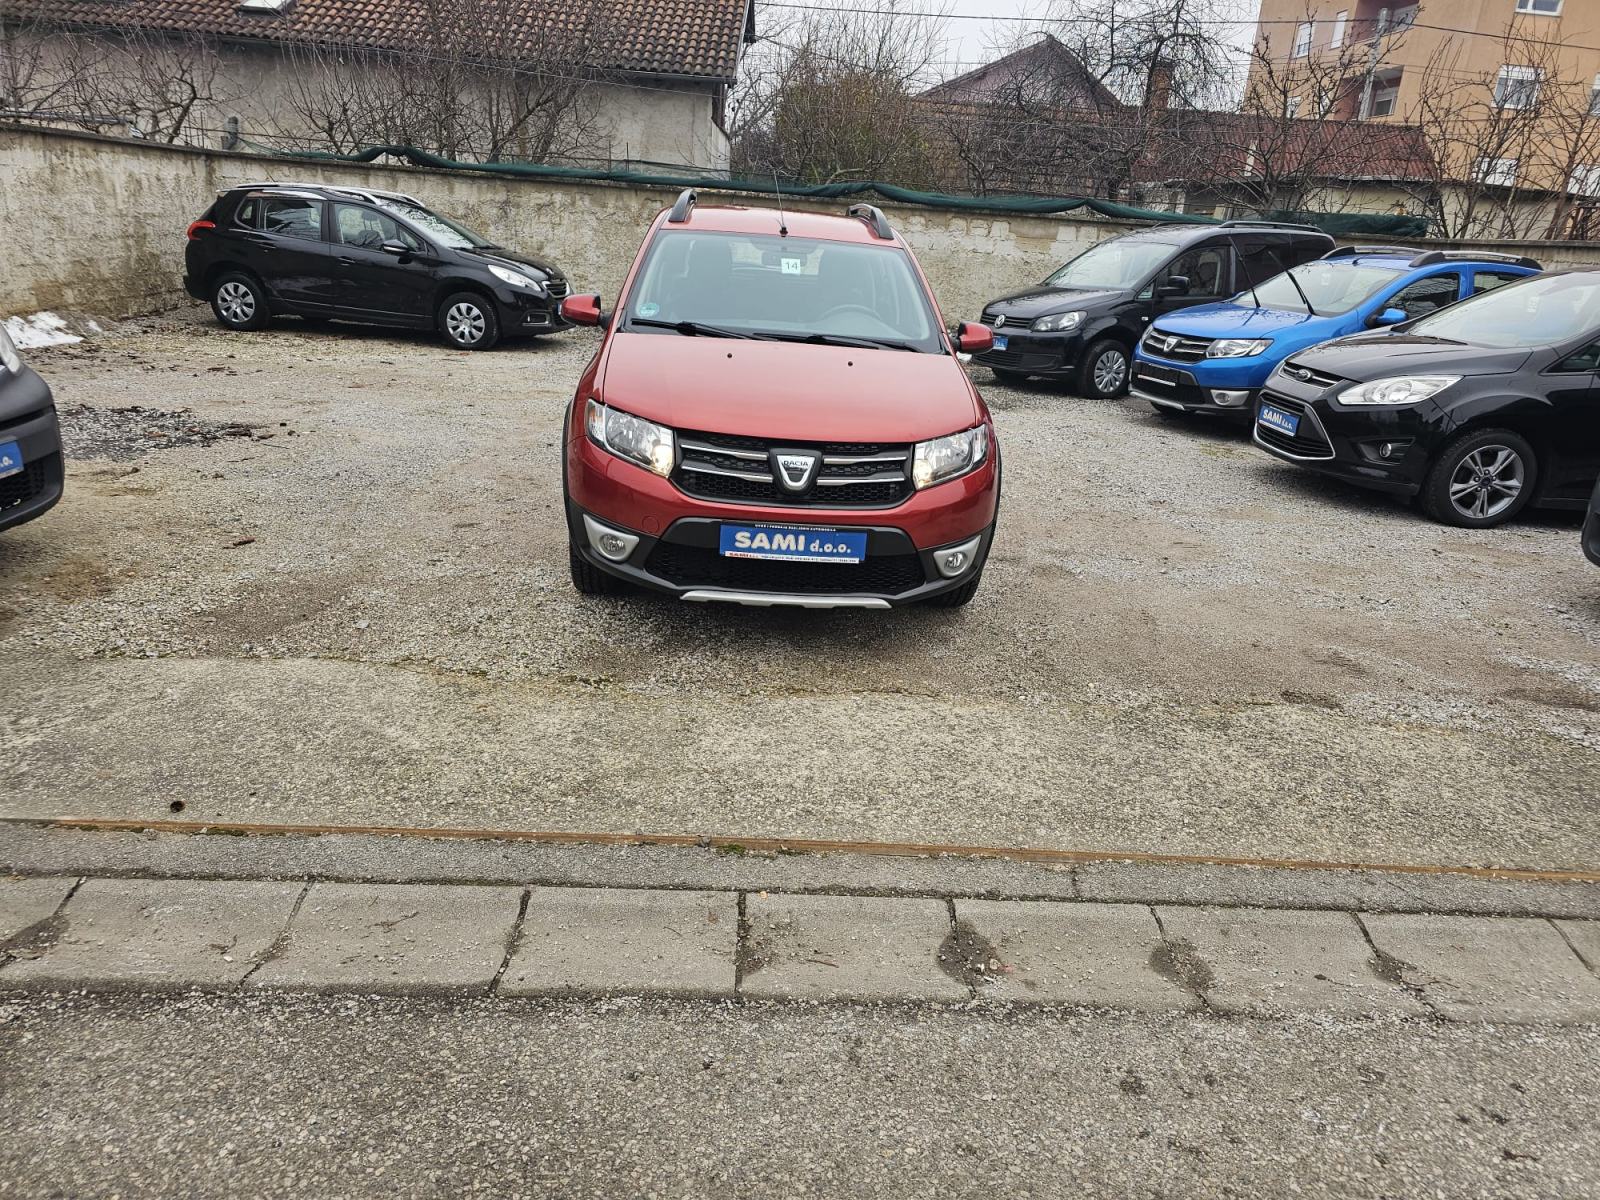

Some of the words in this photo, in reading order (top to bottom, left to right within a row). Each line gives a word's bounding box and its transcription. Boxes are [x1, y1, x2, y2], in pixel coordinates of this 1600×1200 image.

[784, 262, 798, 270] 14
[1262, 409, 1282, 425] SAMI
[734, 531, 806, 551] SAMI
[810, 539, 851, 553] d.o.o.
